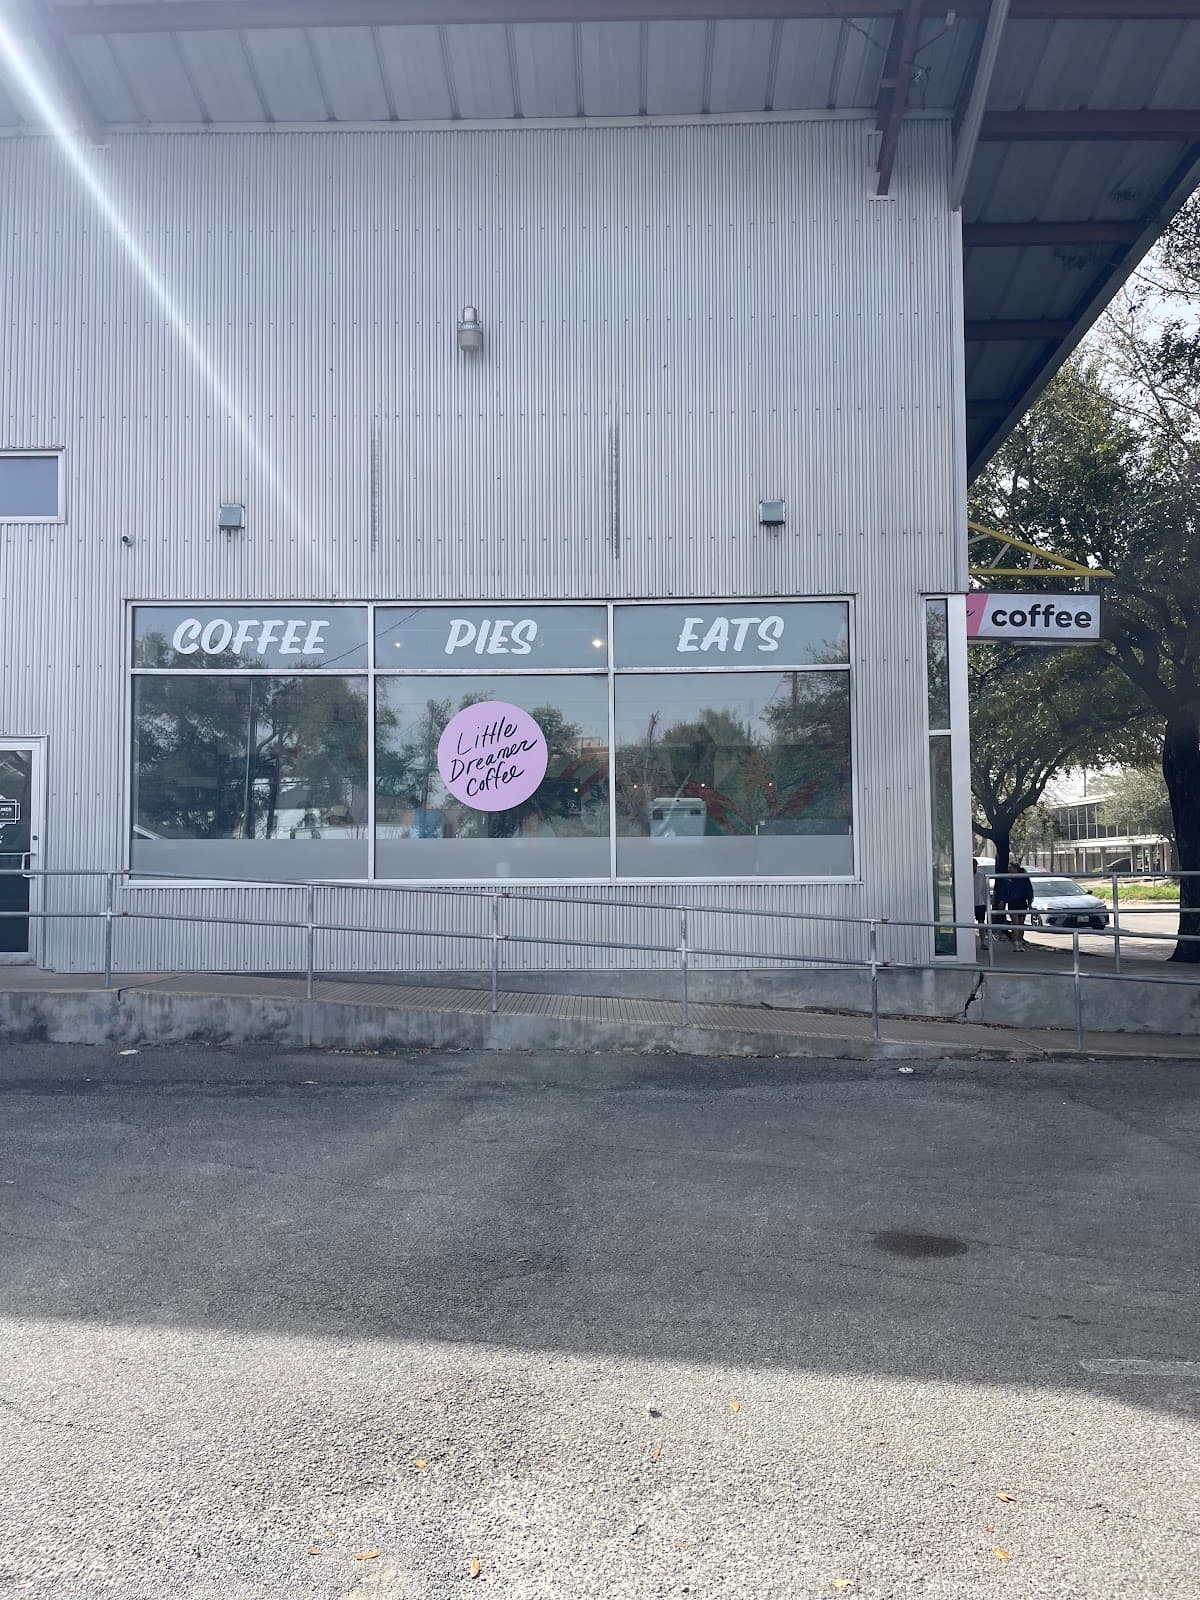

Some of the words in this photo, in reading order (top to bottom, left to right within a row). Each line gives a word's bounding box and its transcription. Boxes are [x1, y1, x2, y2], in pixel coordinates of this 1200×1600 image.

[676, 615, 785, 652] EATS
[991, 603, 1092, 628] coffee
[172, 618, 331, 655] COFFEE
[444, 618, 538, 655] PIES
[457, 716, 518, 755] Little
[449, 739, 538, 783] Dreamer
[466, 761, 525, 796] Coffee
